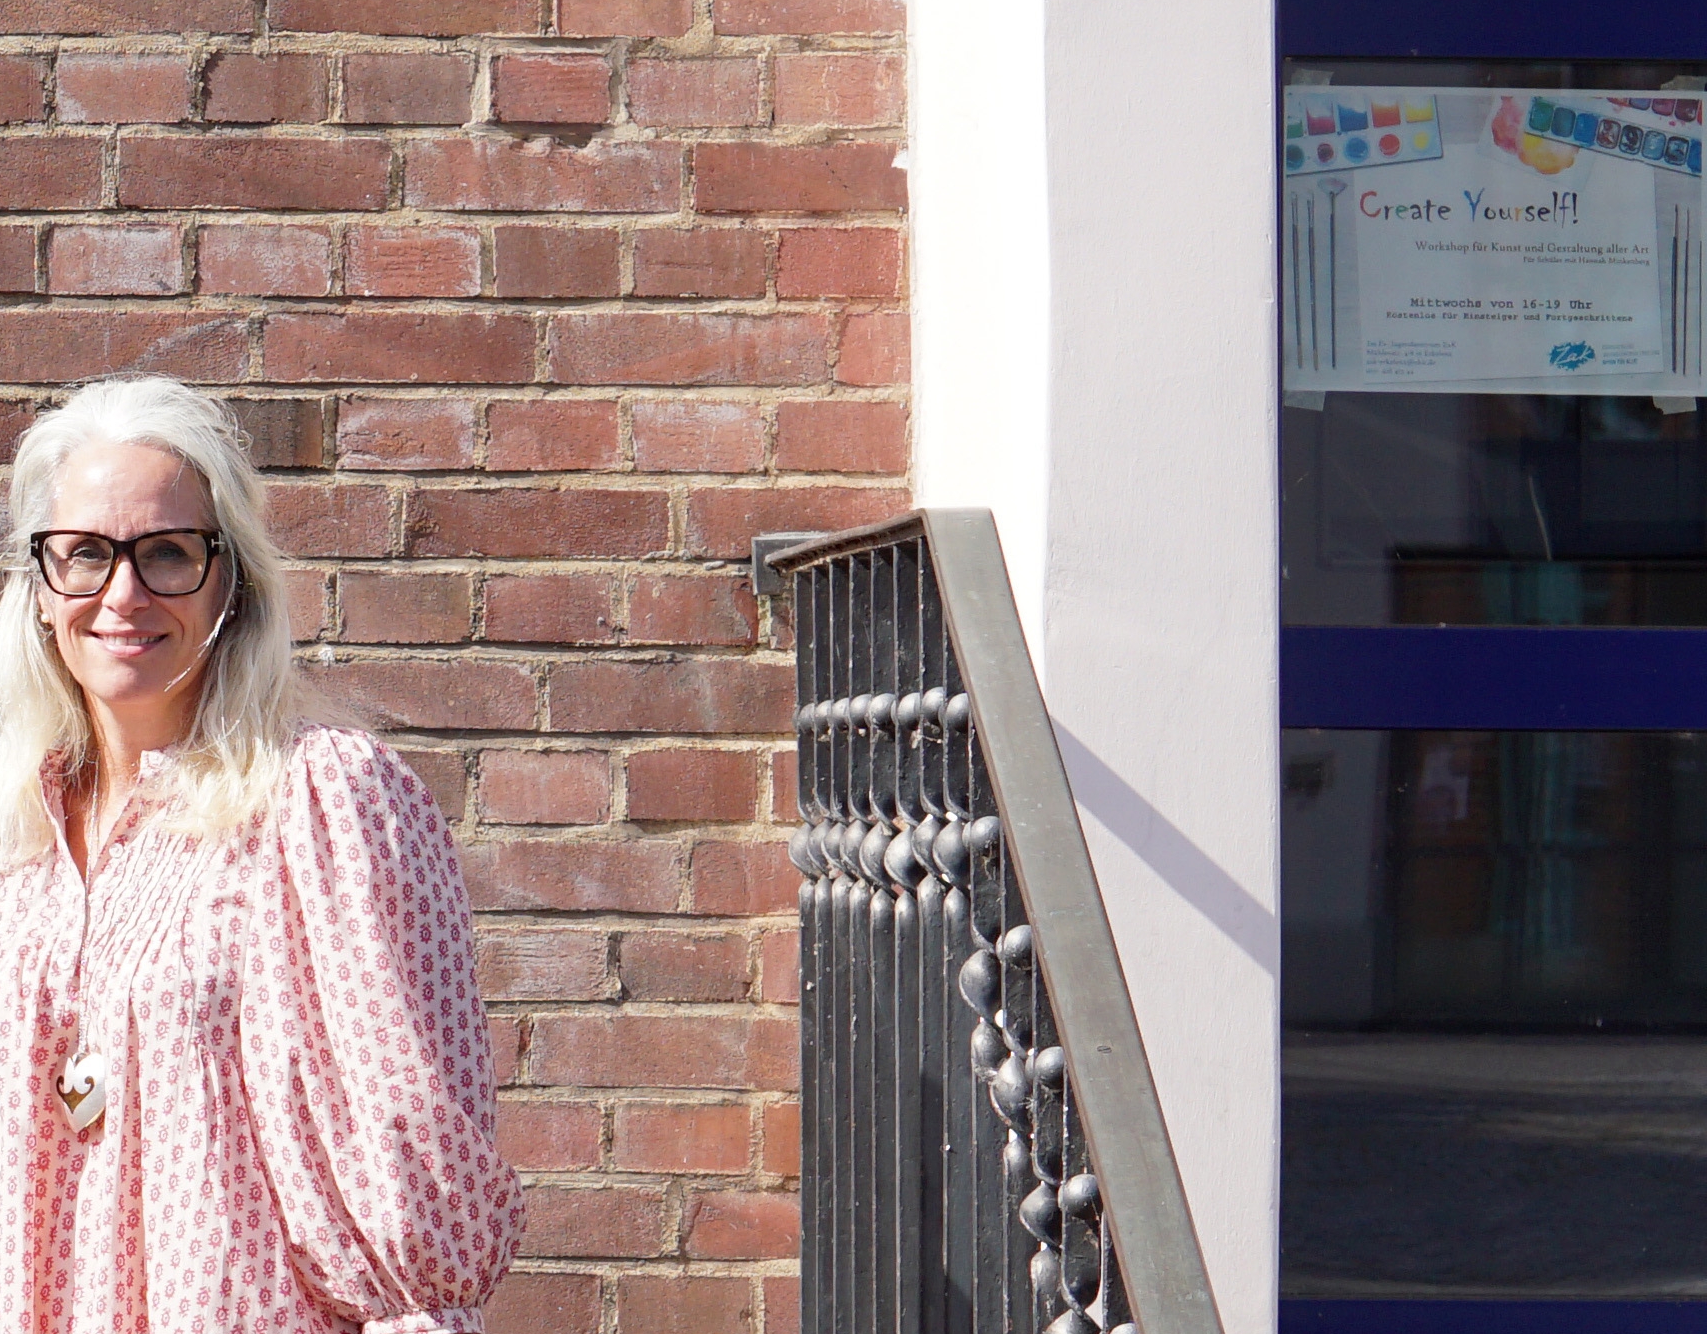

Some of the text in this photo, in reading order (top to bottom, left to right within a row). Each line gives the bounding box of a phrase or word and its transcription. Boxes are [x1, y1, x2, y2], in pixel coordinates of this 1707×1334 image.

[1359, 187, 1578, 228] Create Yourself!
[1416, 241, 1650, 257] Workshop für Kunst und Gestaltung aller Art
[1410, 298, 1593, 310] Mittwochs von 16-19 Uhr
[1386, 311, 1436, 319] Kostenlos
[1442, 311, 1458, 319] für
[1464, 312, 1518, 322] Einsteiger
[1524, 313, 1540, 321] und
